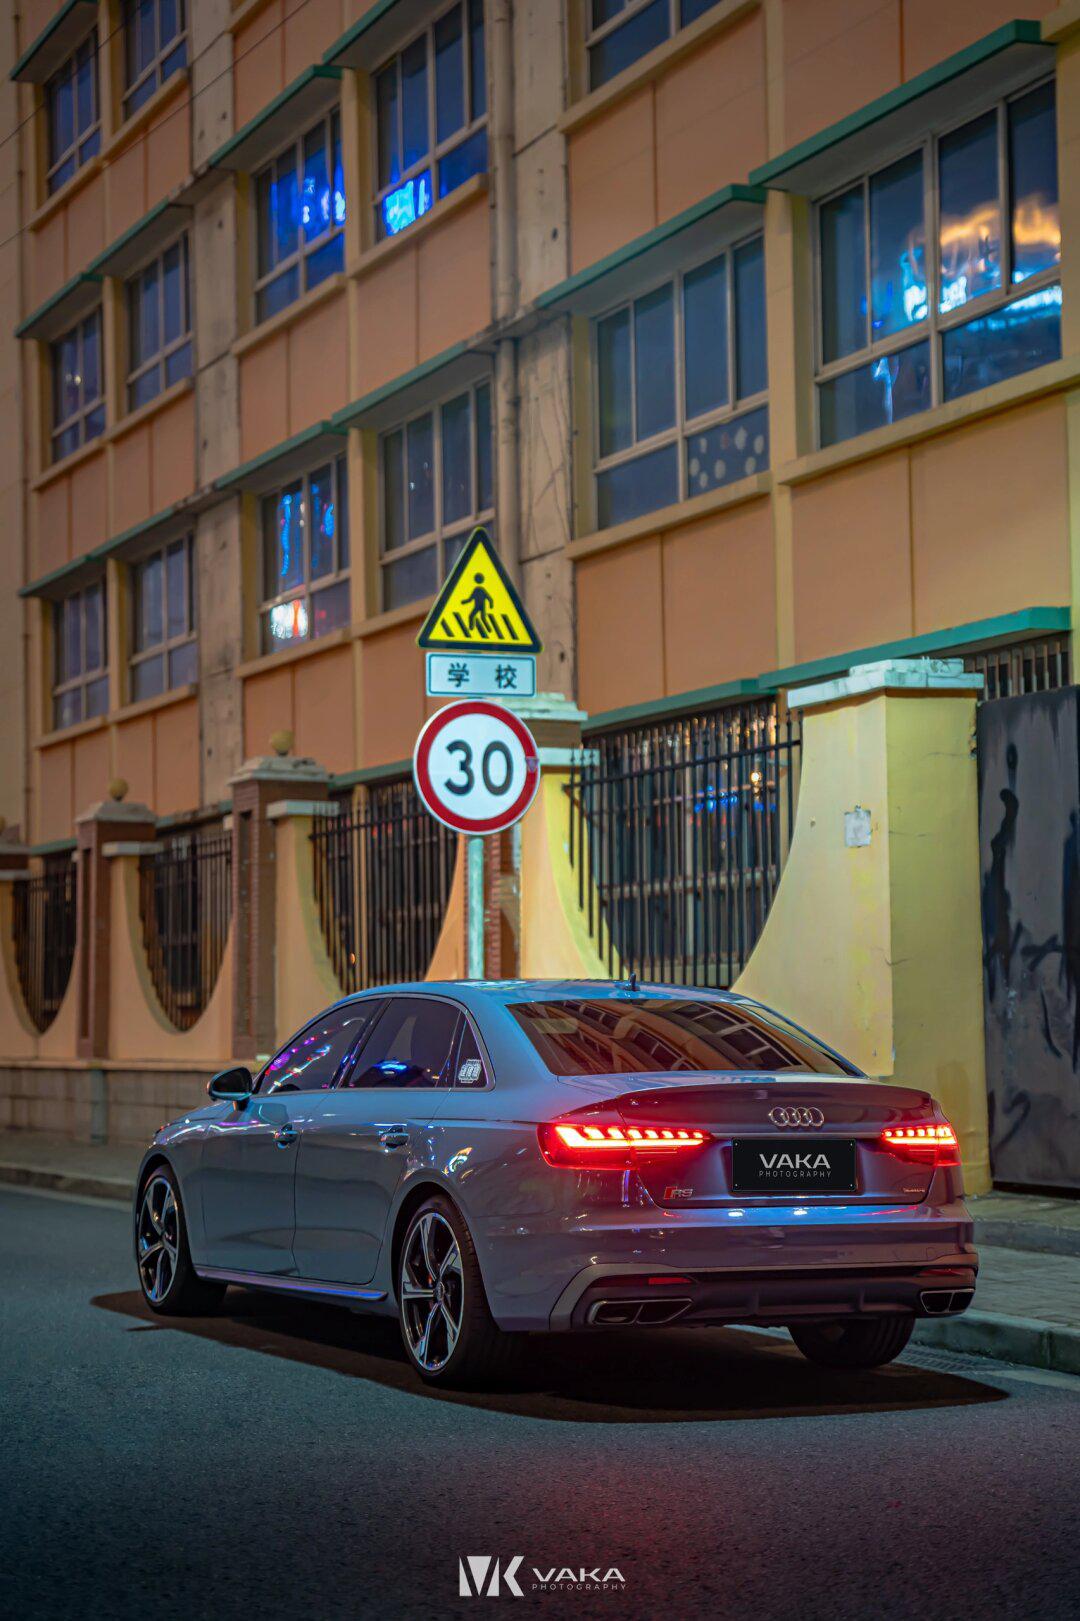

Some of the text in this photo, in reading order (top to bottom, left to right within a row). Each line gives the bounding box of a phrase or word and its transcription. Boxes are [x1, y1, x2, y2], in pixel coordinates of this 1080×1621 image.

[448, 662, 517, 690] 学校
[443, 739, 514, 796] 30
[759, 1153, 831, 1168] VAKA
[759, 1170, 832, 1178] PHOTOGRAPHY
